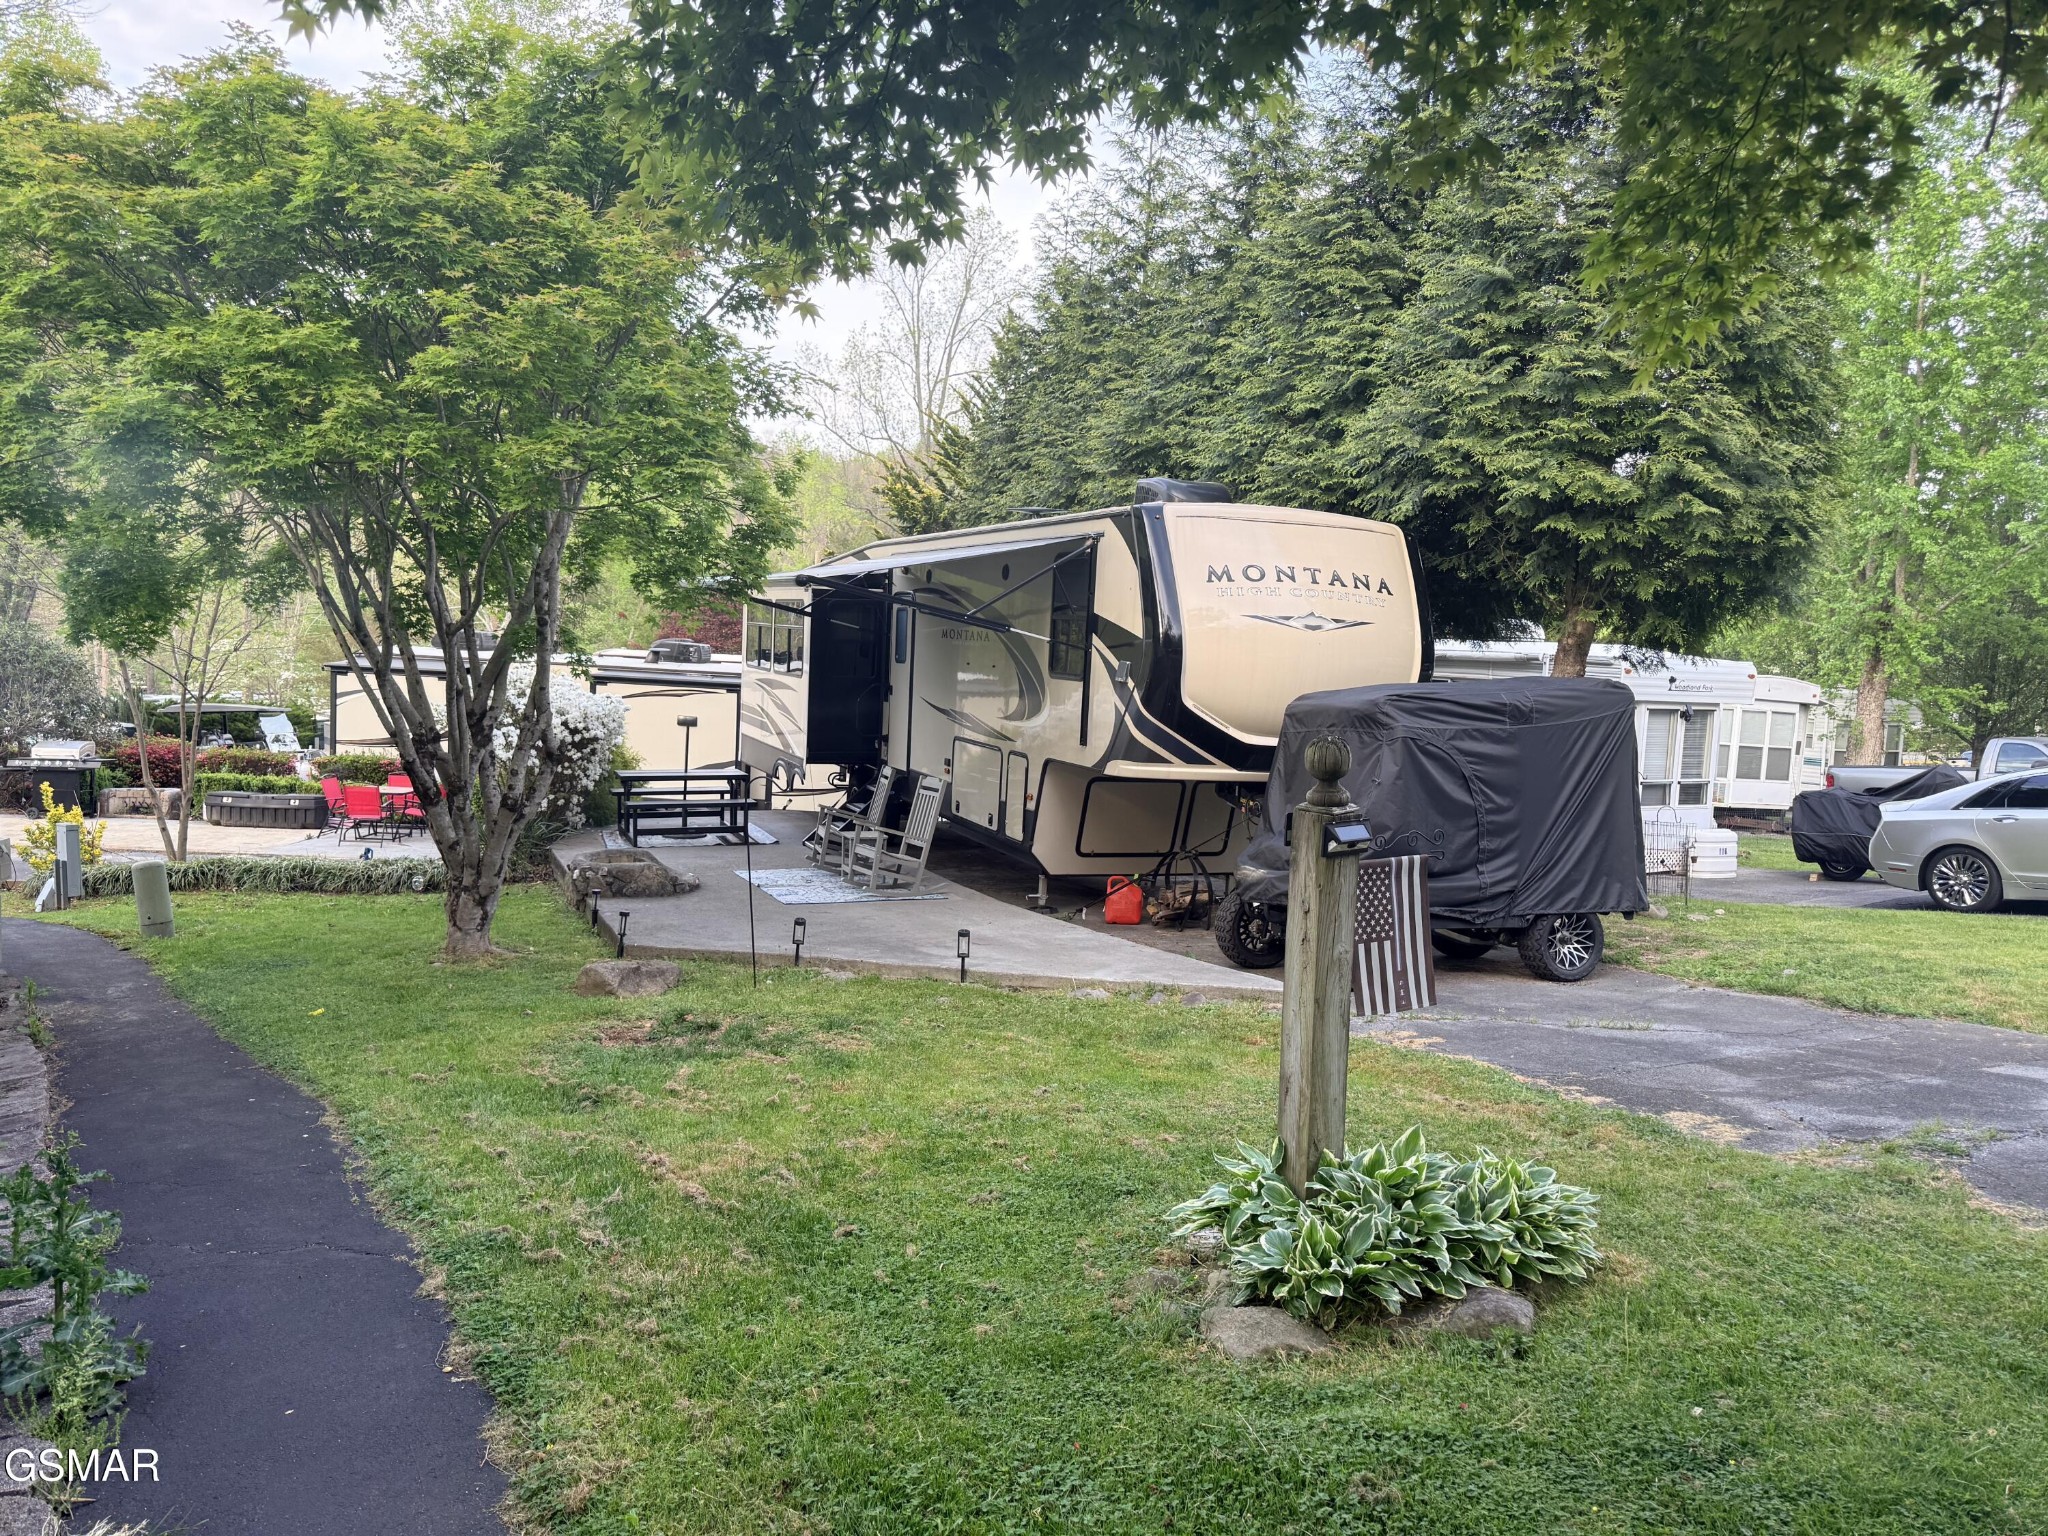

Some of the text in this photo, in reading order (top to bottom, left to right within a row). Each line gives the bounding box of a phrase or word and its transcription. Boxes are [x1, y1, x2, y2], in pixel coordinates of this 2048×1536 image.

[1206, 564, 1394, 596] MONTANA
[1216, 586, 1387, 608] HIGH COUNTRY
[941, 628, 990, 642] MONTANA
